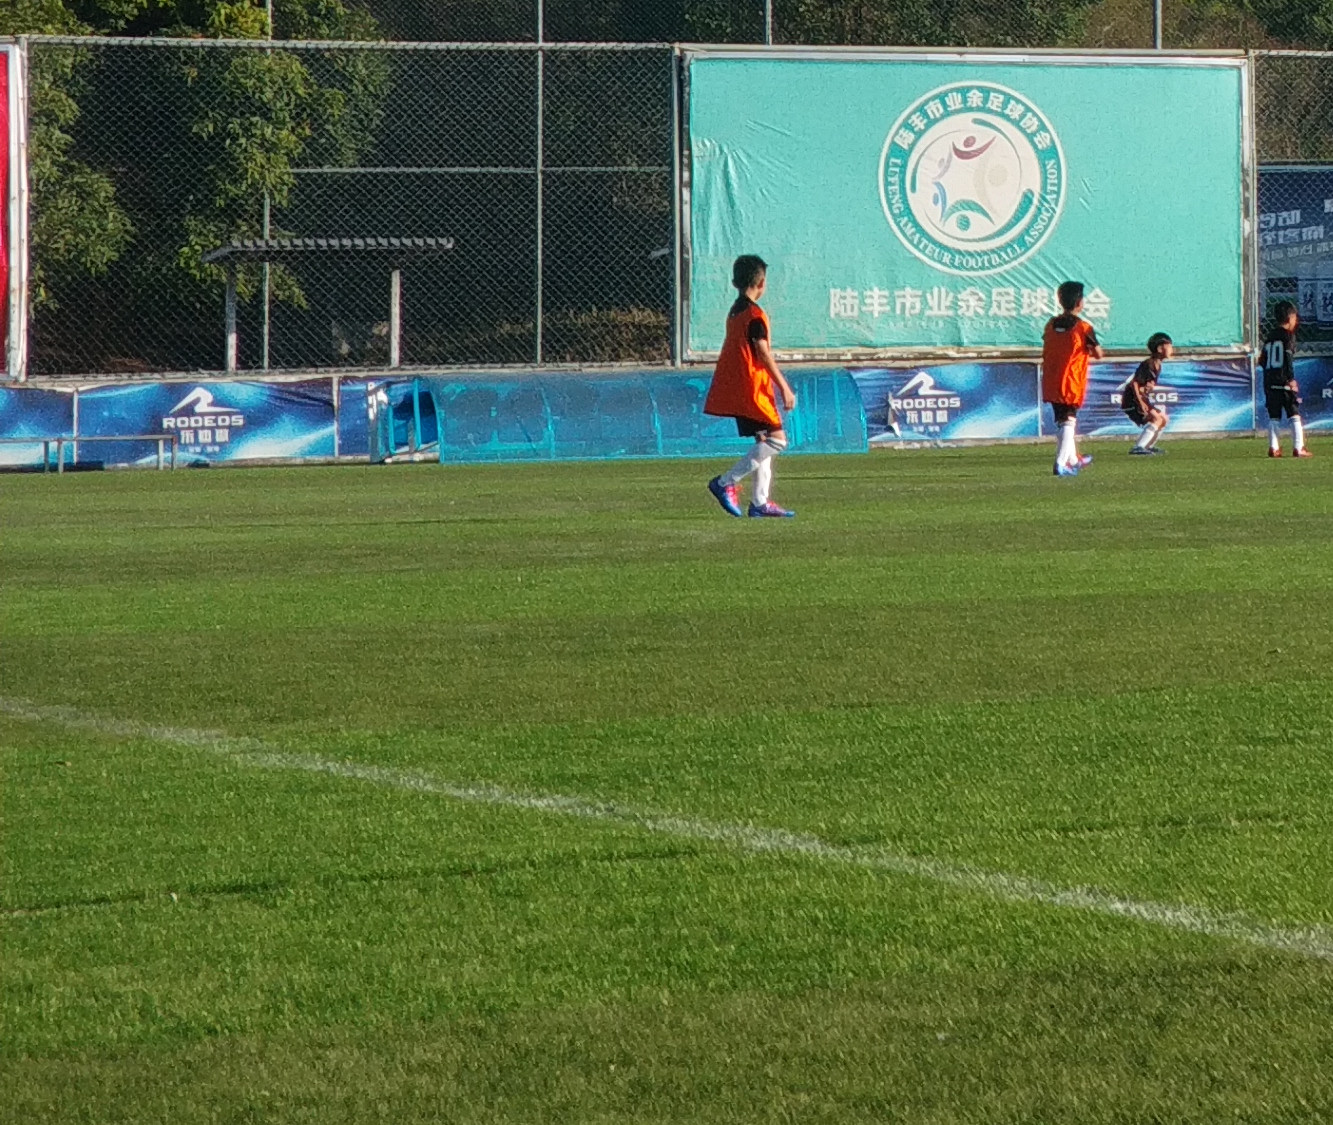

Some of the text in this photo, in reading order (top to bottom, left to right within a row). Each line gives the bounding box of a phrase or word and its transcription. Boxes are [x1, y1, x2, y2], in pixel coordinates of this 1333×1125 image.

[894, 90, 1055, 150] 陆丰市业余足球协会
[898, 216, 955, 264] AMATEUR
[955, 244, 1024, 269] FOOTBALL
[829, 287, 1110, 319] 陆丰市业余足球会
[1265, 340, 1284, 369] 10
[891, 397, 961, 410] RODEOS
[1110, 392, 1179, 404] REOS
[162, 415, 244, 429] RODEOS
